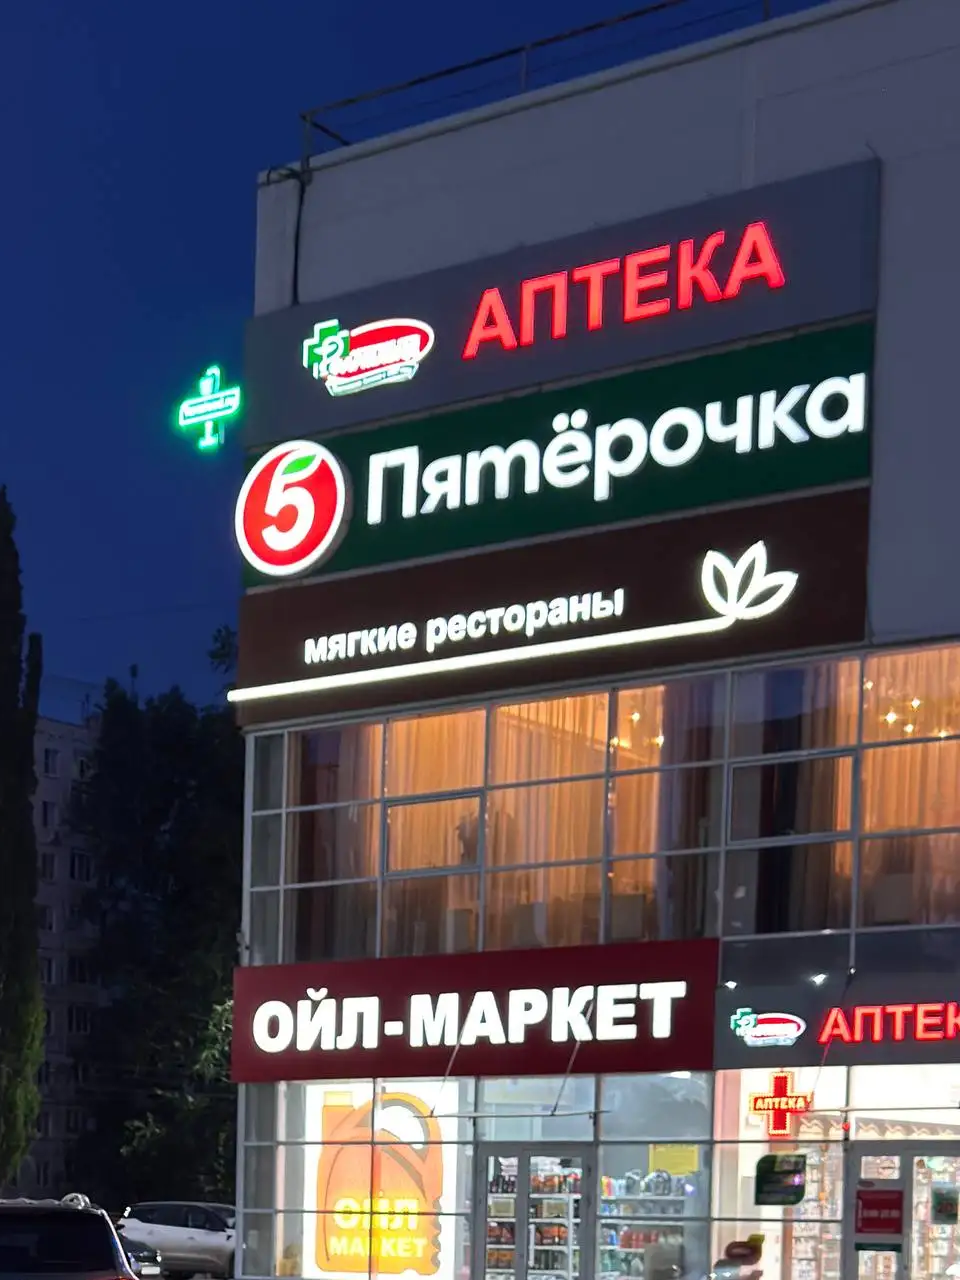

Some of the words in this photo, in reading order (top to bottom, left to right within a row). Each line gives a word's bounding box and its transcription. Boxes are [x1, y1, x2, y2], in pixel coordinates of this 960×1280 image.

[462, 222, 786, 360] АПТЕКА
[367, 373, 865, 525] Пятёрочка
[261, 450, 323, 552] 5
[304, 622, 418, 665] мягкие
[426, 588, 624, 653] рестораны
[252, 982, 687, 1053] ОЙЛ-МАРКЕТ
[754, 1096, 805, 1110] АПТЕКА
